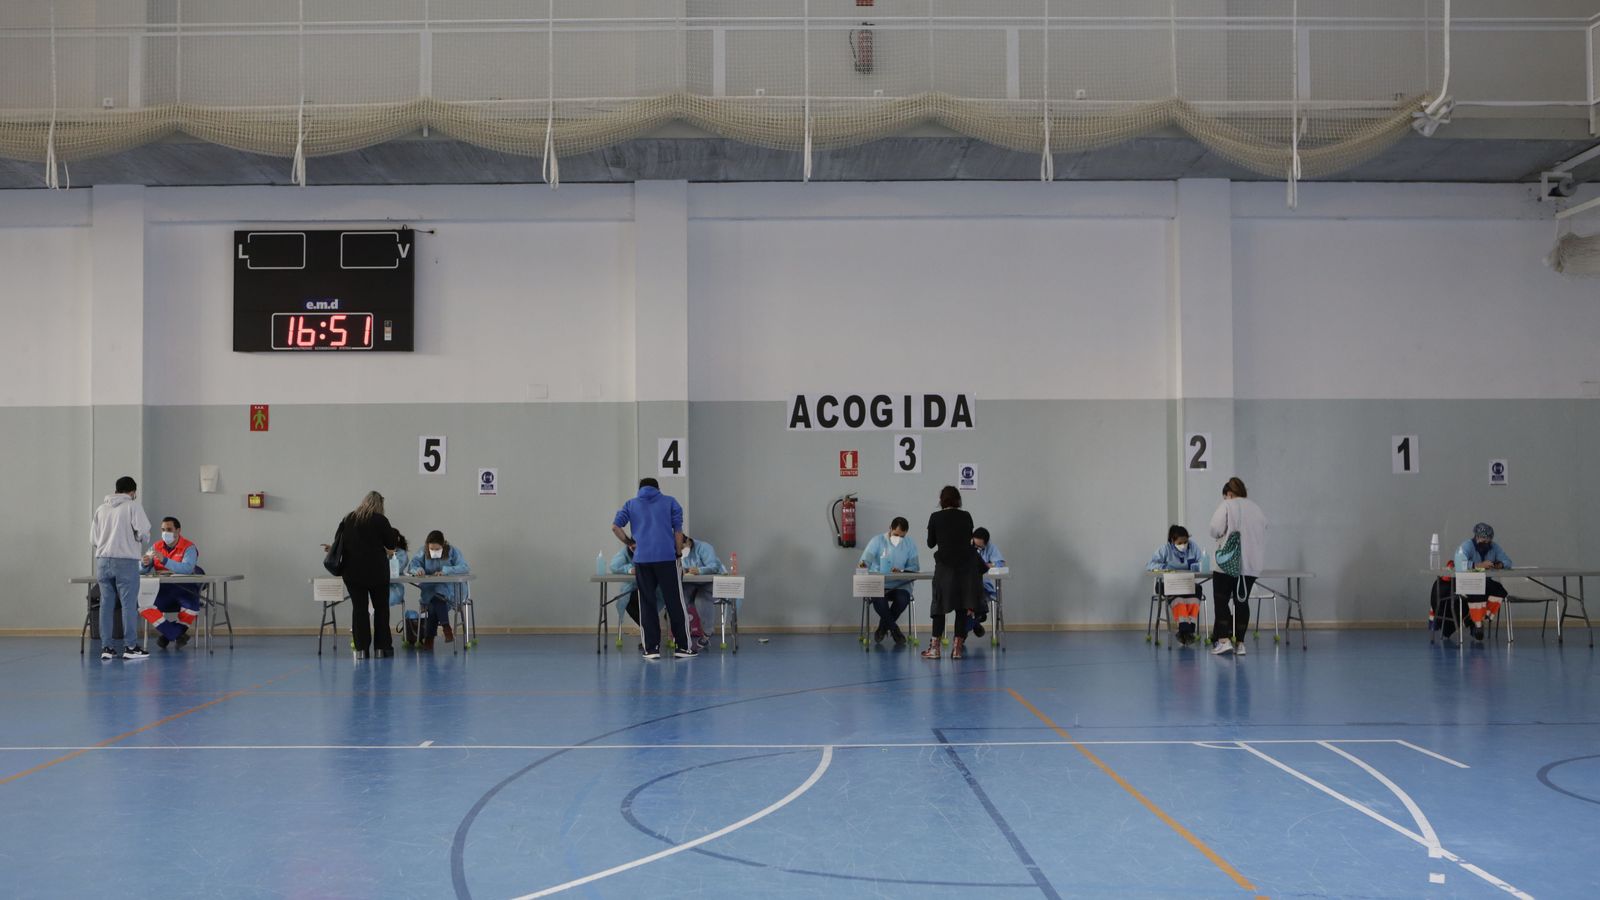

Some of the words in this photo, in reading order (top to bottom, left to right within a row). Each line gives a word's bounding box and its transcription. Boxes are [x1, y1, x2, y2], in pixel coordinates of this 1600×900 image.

[238, 243, 249, 259] L
[397, 243, 410, 259] V
[306, 299, 339, 310] e.m.d
[287, 315, 372, 346] 16:51
[789, 394, 973, 429] ACOGIDA
[423, 438, 441, 472] 5
[662, 440, 681, 474] 4
[899, 436, 917, 471] 3
[1190, 435, 1207, 469] 2
[1397, 437, 1411, 471] 1
